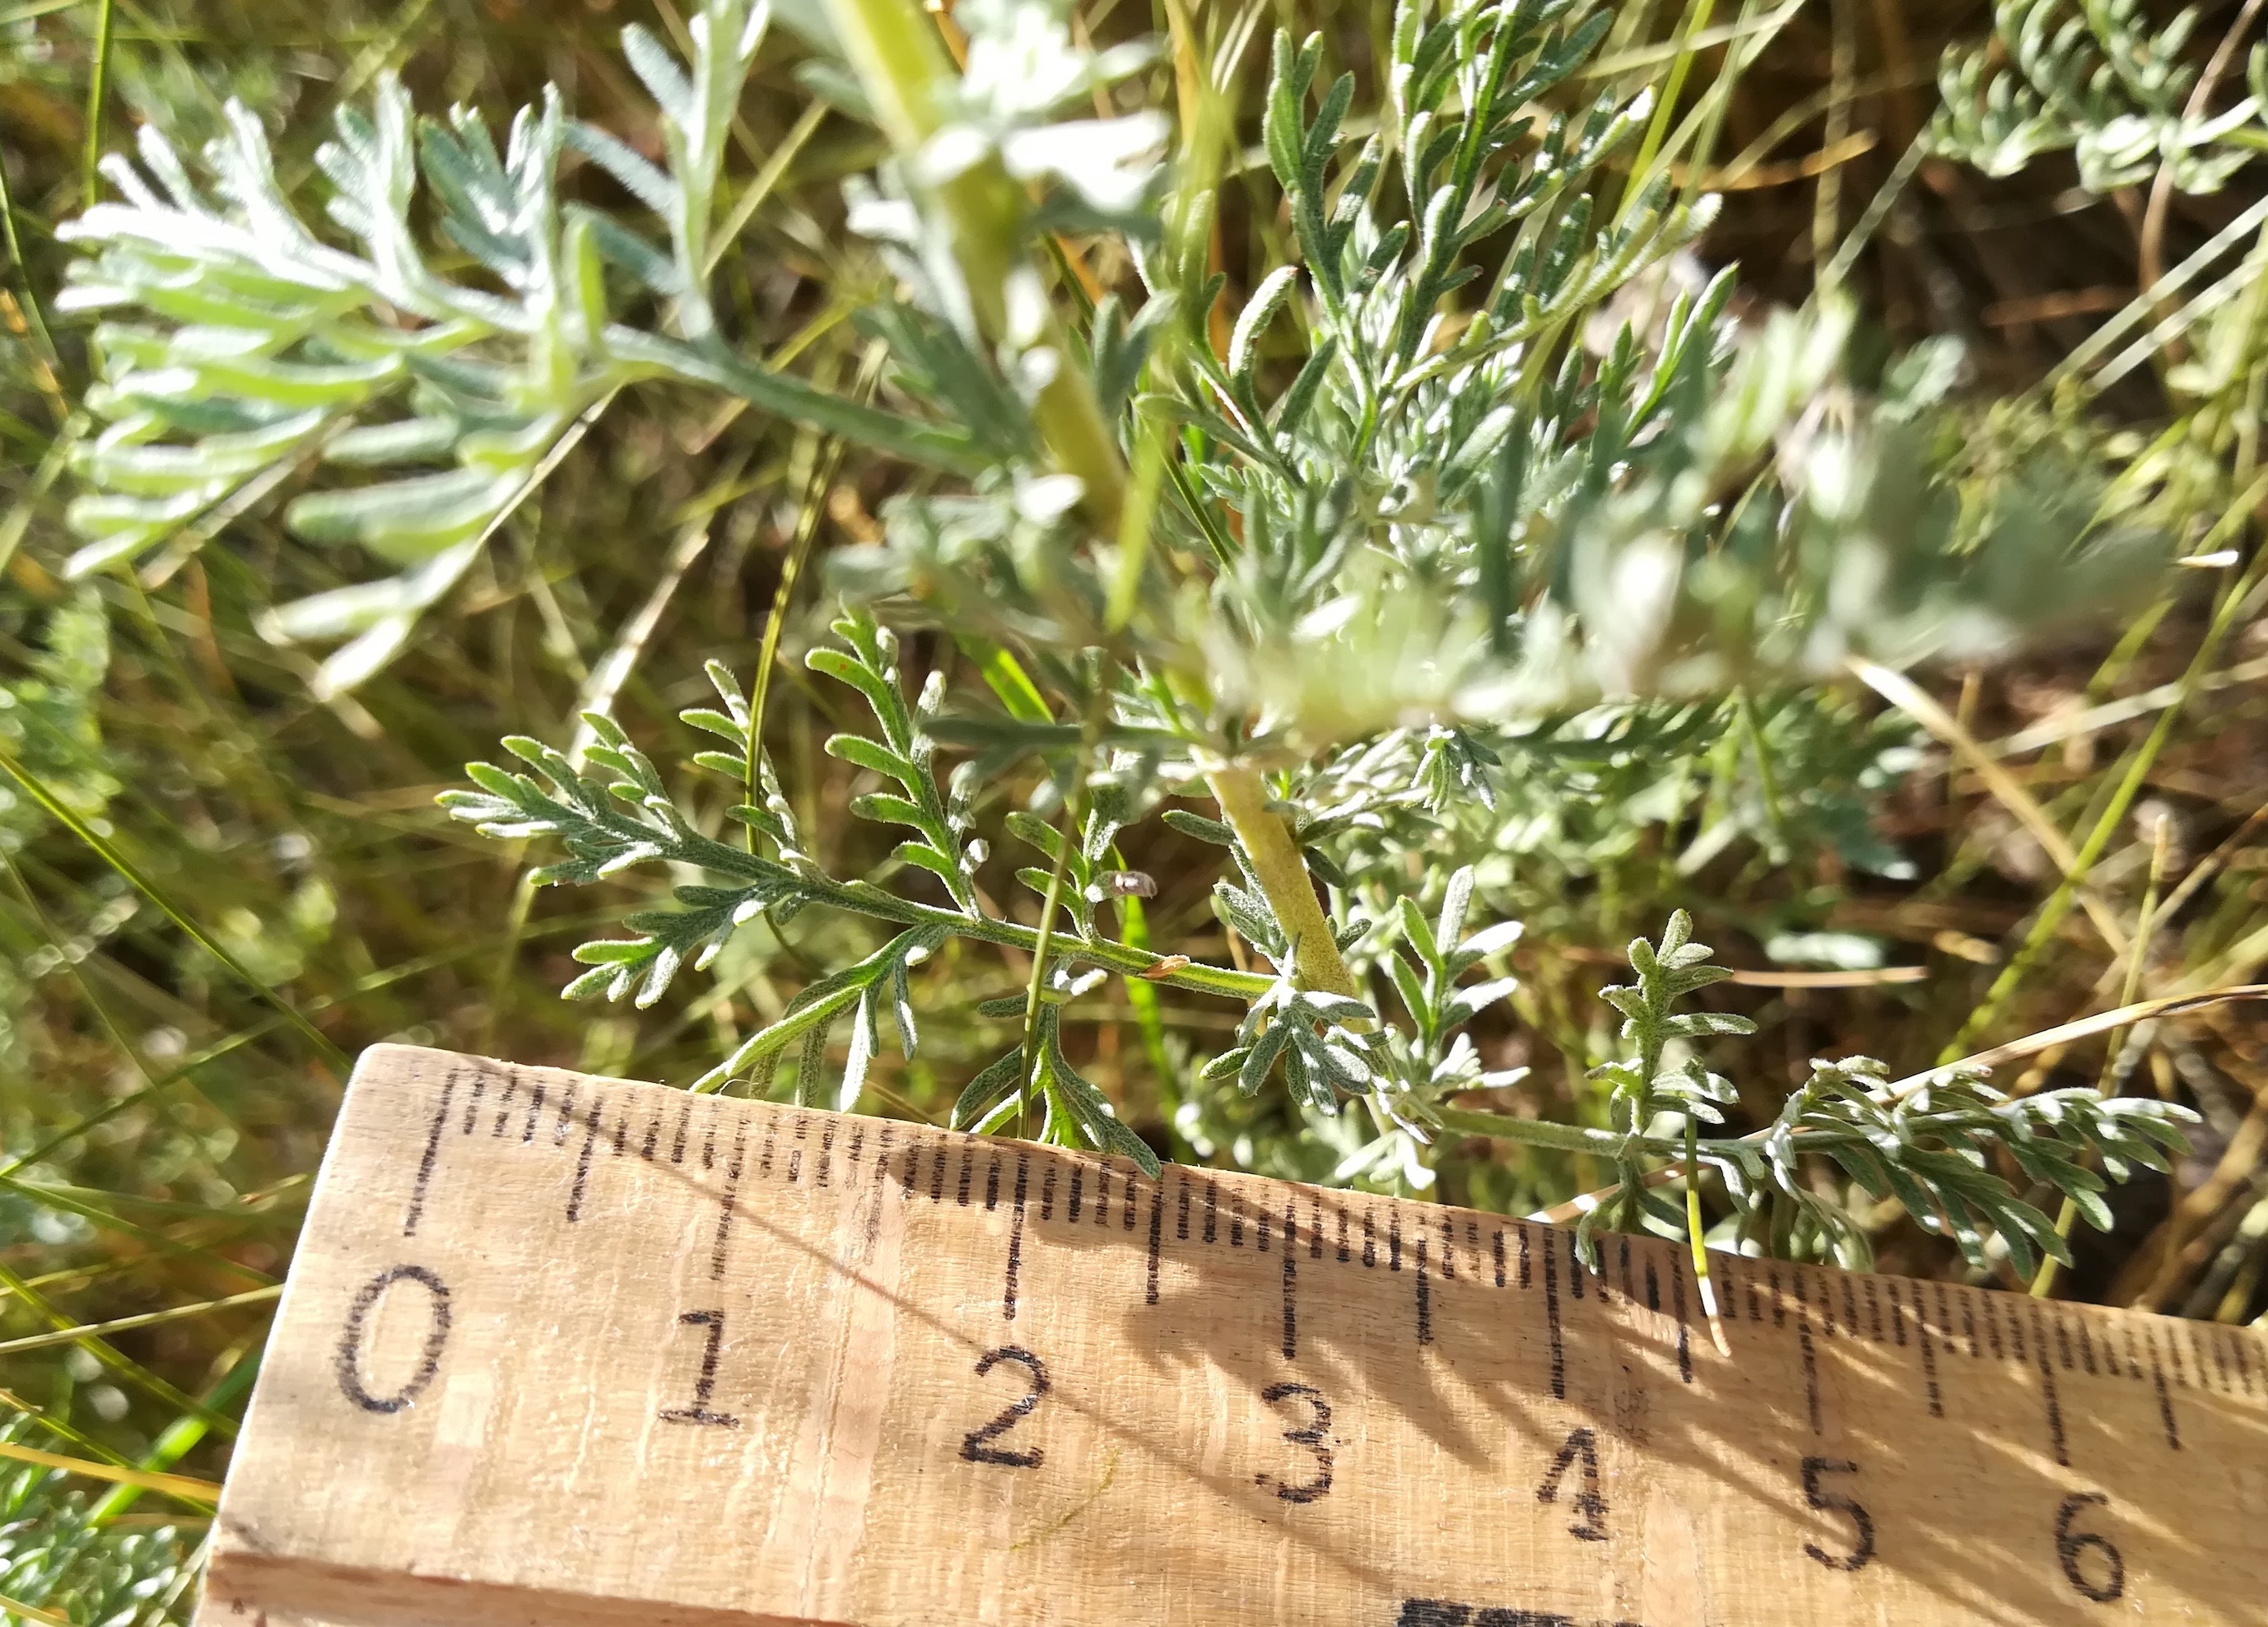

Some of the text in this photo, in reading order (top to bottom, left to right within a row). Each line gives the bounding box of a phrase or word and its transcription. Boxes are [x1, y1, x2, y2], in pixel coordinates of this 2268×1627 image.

[337, 1265, 2124, 1603] 0 1 2 3 4 5 6
